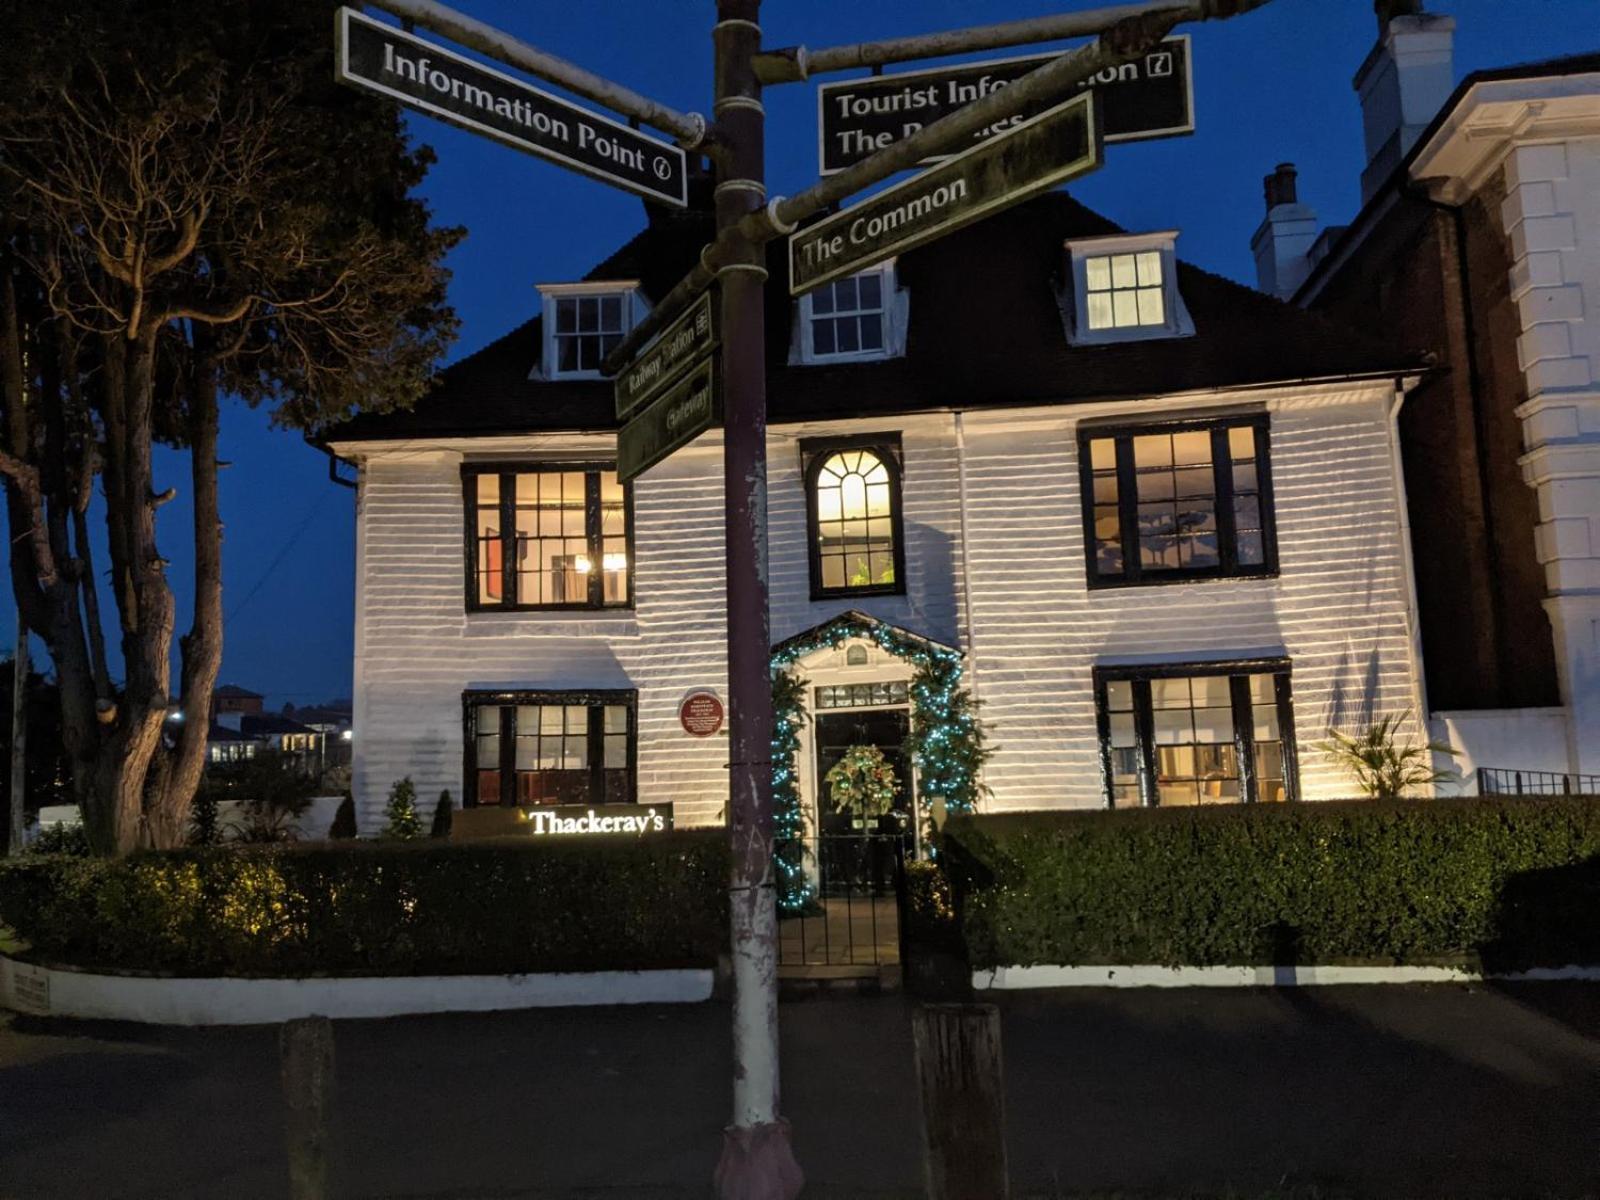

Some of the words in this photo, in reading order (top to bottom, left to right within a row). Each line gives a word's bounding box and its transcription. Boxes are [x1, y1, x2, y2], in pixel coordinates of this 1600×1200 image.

[383, 43, 569, 142] Information
[577, 121, 645, 172] Point
[836, 85, 939, 119] Tourist
[803, 235, 843, 267] The
[850, 178, 967, 245] Common
[629, 355, 662, 394] Railway
[529, 809, 664, 837] Thackeray's
